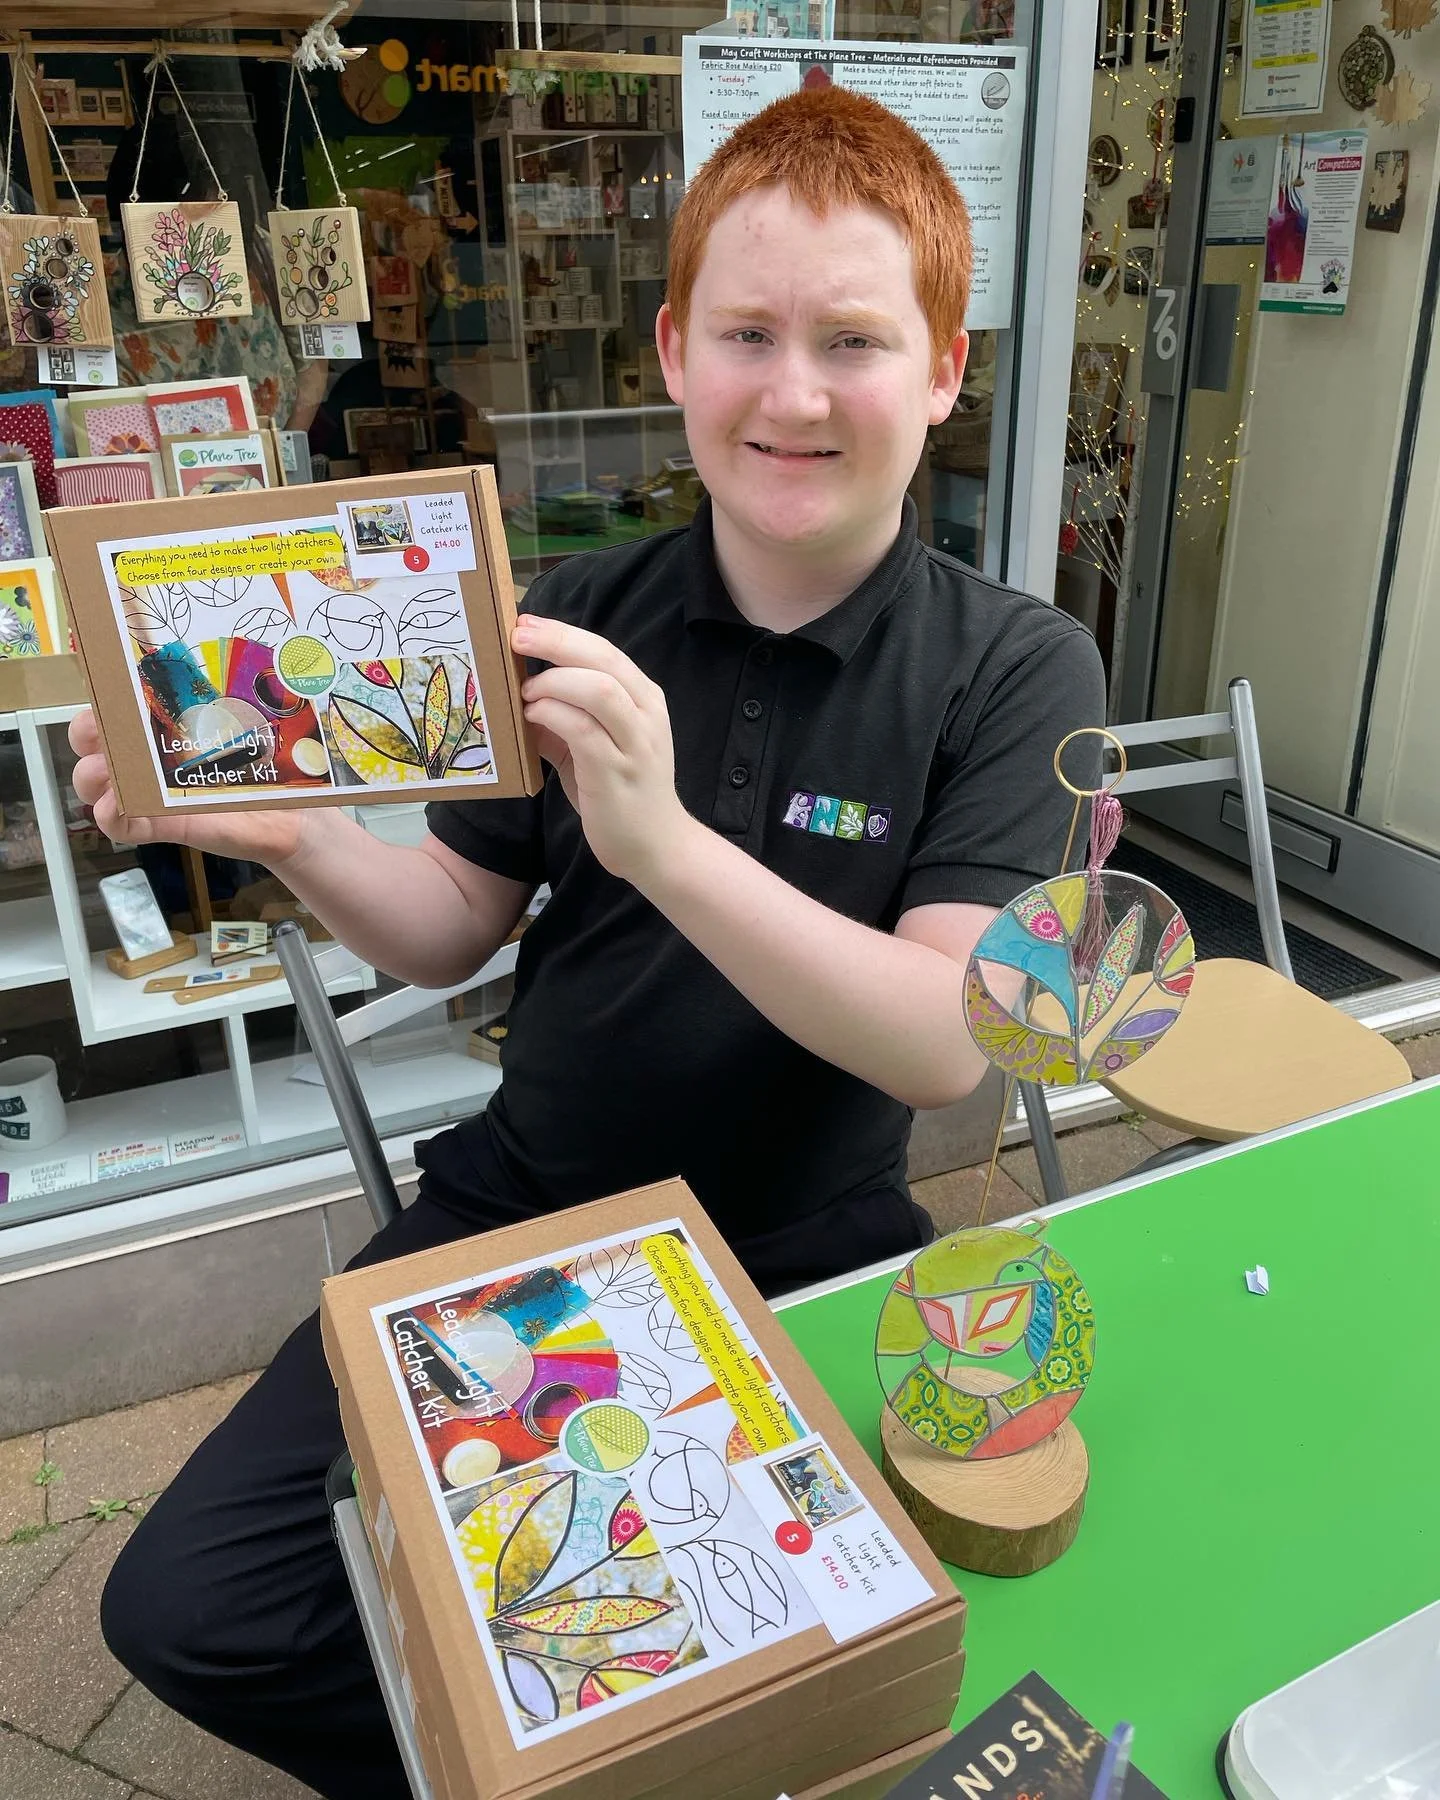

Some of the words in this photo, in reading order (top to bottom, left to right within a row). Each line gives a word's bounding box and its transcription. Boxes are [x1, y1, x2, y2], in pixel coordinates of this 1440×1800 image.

[721, 48, 738, 60] May
[740, 49, 761, 59] Craft
[763, 50, 802, 62] Workshops
[803, 52, 812, 60] at
[814, 51, 827, 60] The
[829, 52, 849, 61] Plane
[850, 52, 866, 61] Tree
[873, 54, 905, 63] Materials
[907, 54, 921, 63] and
[923, 55, 968, 65] Refreshments
[969, 57, 999, 66] Provided
[701, 61, 723, 70] Fabric
[725, 62, 740, 70] Rose
[742, 63, 767, 73] Making
[769, 63, 782, 72] £20
[868, 66, 887, 74] bunch
[888, 67, 896, 76] of
[897, 67, 916, 76] fabric
[717, 75, 745, 86] Tuesday
[842, 79, 868, 87] organza
[919, 79, 932, 88] soft
[933, 80, 955, 89] fabrics
[717, 89, 759, 100] 5:30-7:30pm
[880, 90, 898, 98] which
[899, 92, 913, 101] may
[923, 91, 944, 100] added
[701, 110, 720, 119] Fused
[722, 110, 740, 119] Glass
[939, 128, 960, 137] process
[1303, 160, 1317, 170] Art
[1319, 157, 1361, 171] Competition
[1153, 288, 1177, 360] 76
[198, 449, 233, 464] Plane
[234, 448, 258, 462] Tree
[424, 498, 453, 508] Leaded
[431, 512, 453, 524] Light
[420, 525, 453, 535] Catcher
[455, 523, 469, 531] Kit
[434, 539, 461, 549] £14.00
[120, 553, 167, 567] Everything
[168, 553, 186, 565] you
[189, 548, 208, 560] need
[210, 547, 221, 556] to
[224, 544, 248, 556] make
[250, 542, 268, 554] two
[271, 540, 291, 555] light
[294, 537, 336, 549] catchers.
[413, 555, 420, 565] 5
[128, 571, 161, 582] Choose
[162, 568, 186, 579] from
[187, 565, 207, 576] four
[210, 564, 242, 577] designs
[245, 563, 256, 571] or
[259, 558, 288, 569] create
[290, 558, 314, 570] your
[316, 556, 337, 564] own.
[297, 678, 316, 688] Plane
[316, 677, 331, 687] Tree
[160, 728, 224, 754] Leaded
[231, 721, 276, 756] Light
[174, 764, 246, 786] Catcher
[251, 760, 279, 782] Kit
[174, 1135, 215, 1148] MEADOW
[664, 1237, 692, 1280] Everything
[684, 1279, 702, 1297] you
[699, 1298, 719, 1317] need
[711, 1318, 722, 1330] to
[718, 1331, 738, 1356] make
[734, 1357, 750, 1376] two
[743, 1377, 767, 1400] light
[435, 1297, 485, 1364] Leaded
[647, 1244, 668, 1275] Choose
[664, 1275, 680, 1298] from
[677, 1298, 693, 1320] four
[689, 1320, 713, 1354] designs
[710, 1355, 721, 1366] or
[717, 1369, 740, 1399] create
[729, 1401, 755, 1425] your
[752, 1427, 767, 1451] own.
[393, 1317, 435, 1391] Catcher
[418, 1395, 454, 1429] Kit
[455, 1366, 505, 1418] Light
[583, 1451, 598, 1469] Tree
[786, 1533, 800, 1543] 5
[858, 1542, 881, 1571] Light
[871, 1530, 902, 1568] Leaded
[832, 1534, 862, 1574] Catcher
[859, 1576, 877, 1595] Kit
[821, 1555, 849, 1590] £14.00
